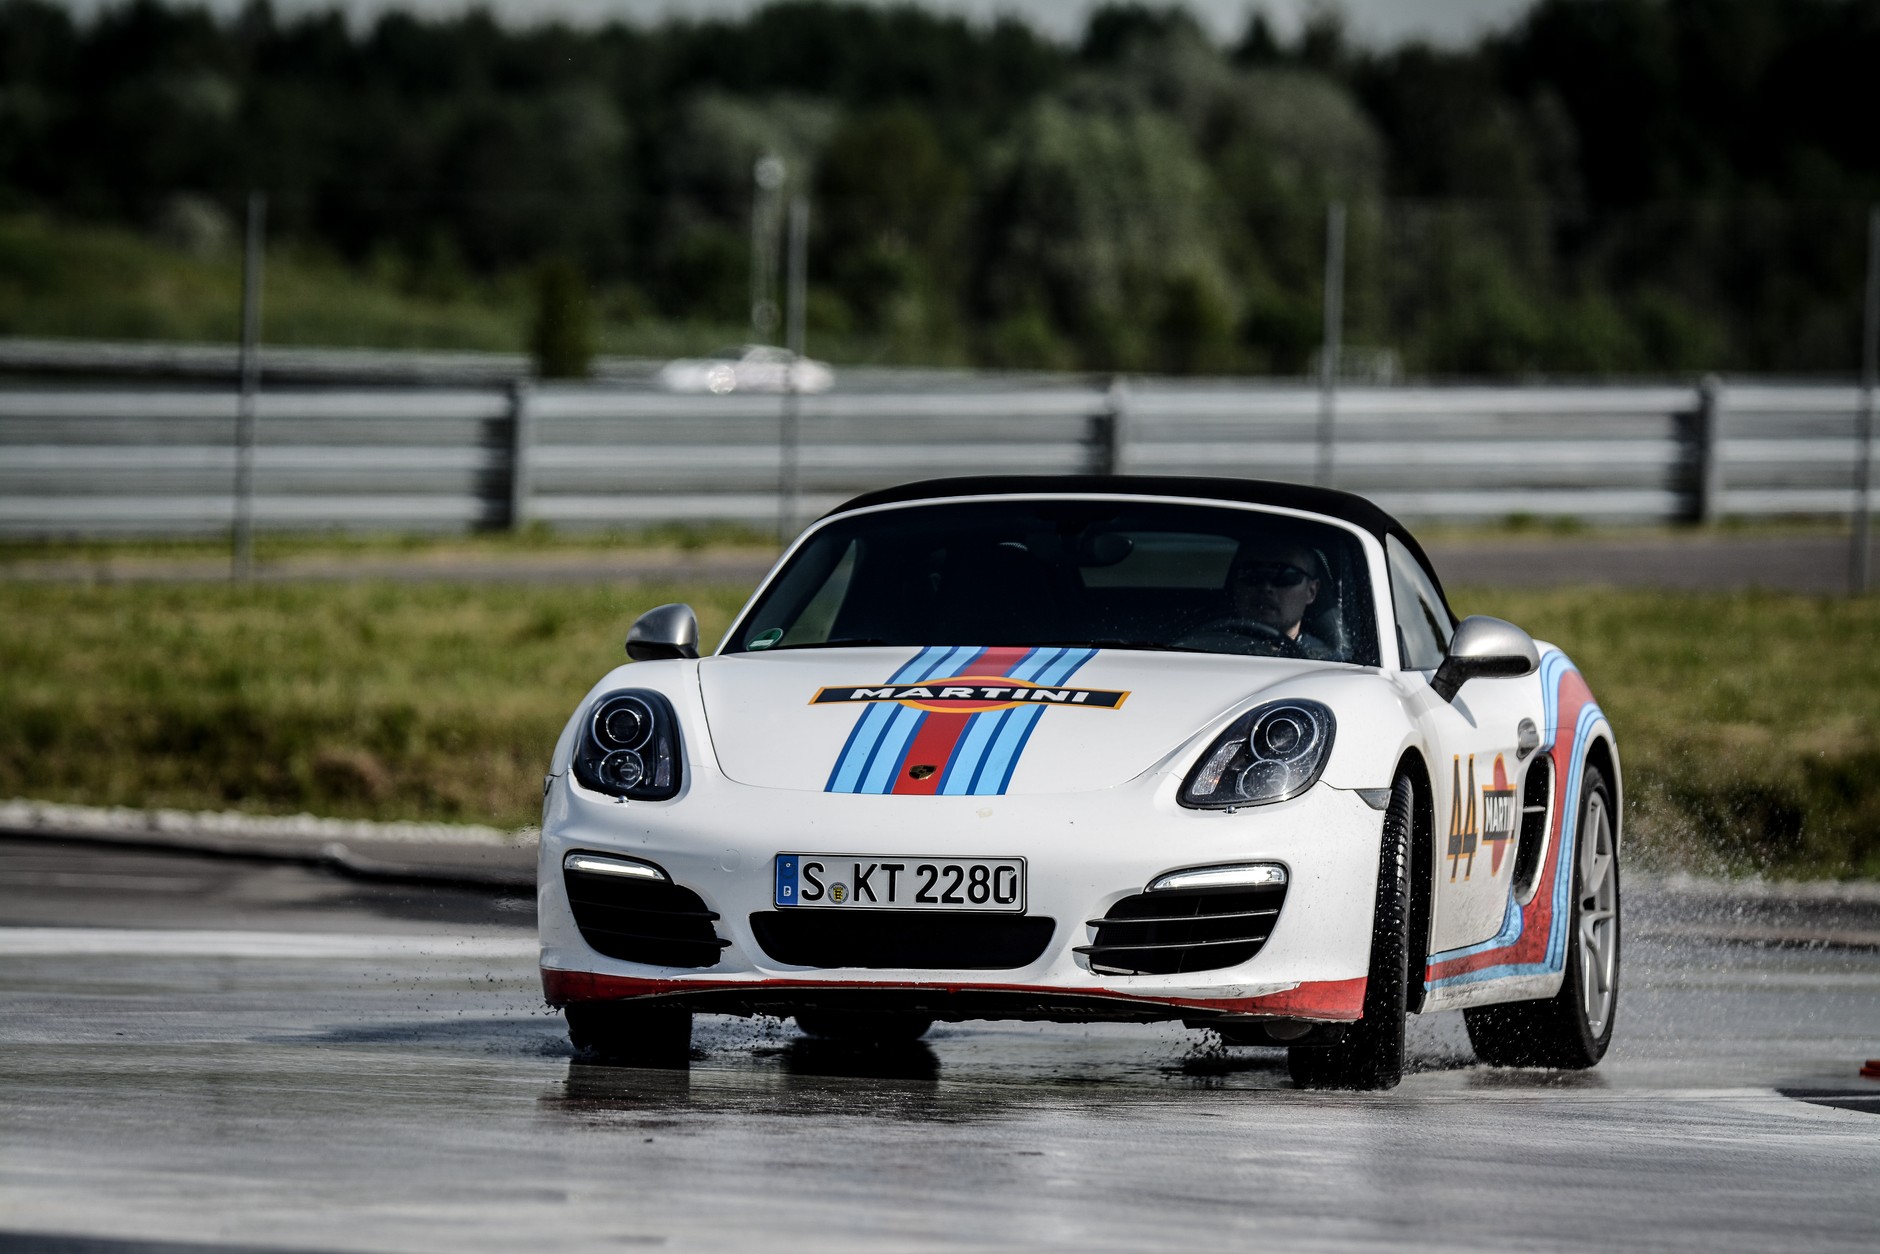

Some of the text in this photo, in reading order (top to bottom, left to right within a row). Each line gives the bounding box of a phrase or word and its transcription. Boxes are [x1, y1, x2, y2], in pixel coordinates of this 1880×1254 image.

[849, 686, 1090, 703] MARTINI
[1447, 754, 1479, 883] 44
[801, 862, 826, 901] S
[853, 863, 905, 903] KT
[915, 865, 1017, 905] 2280
